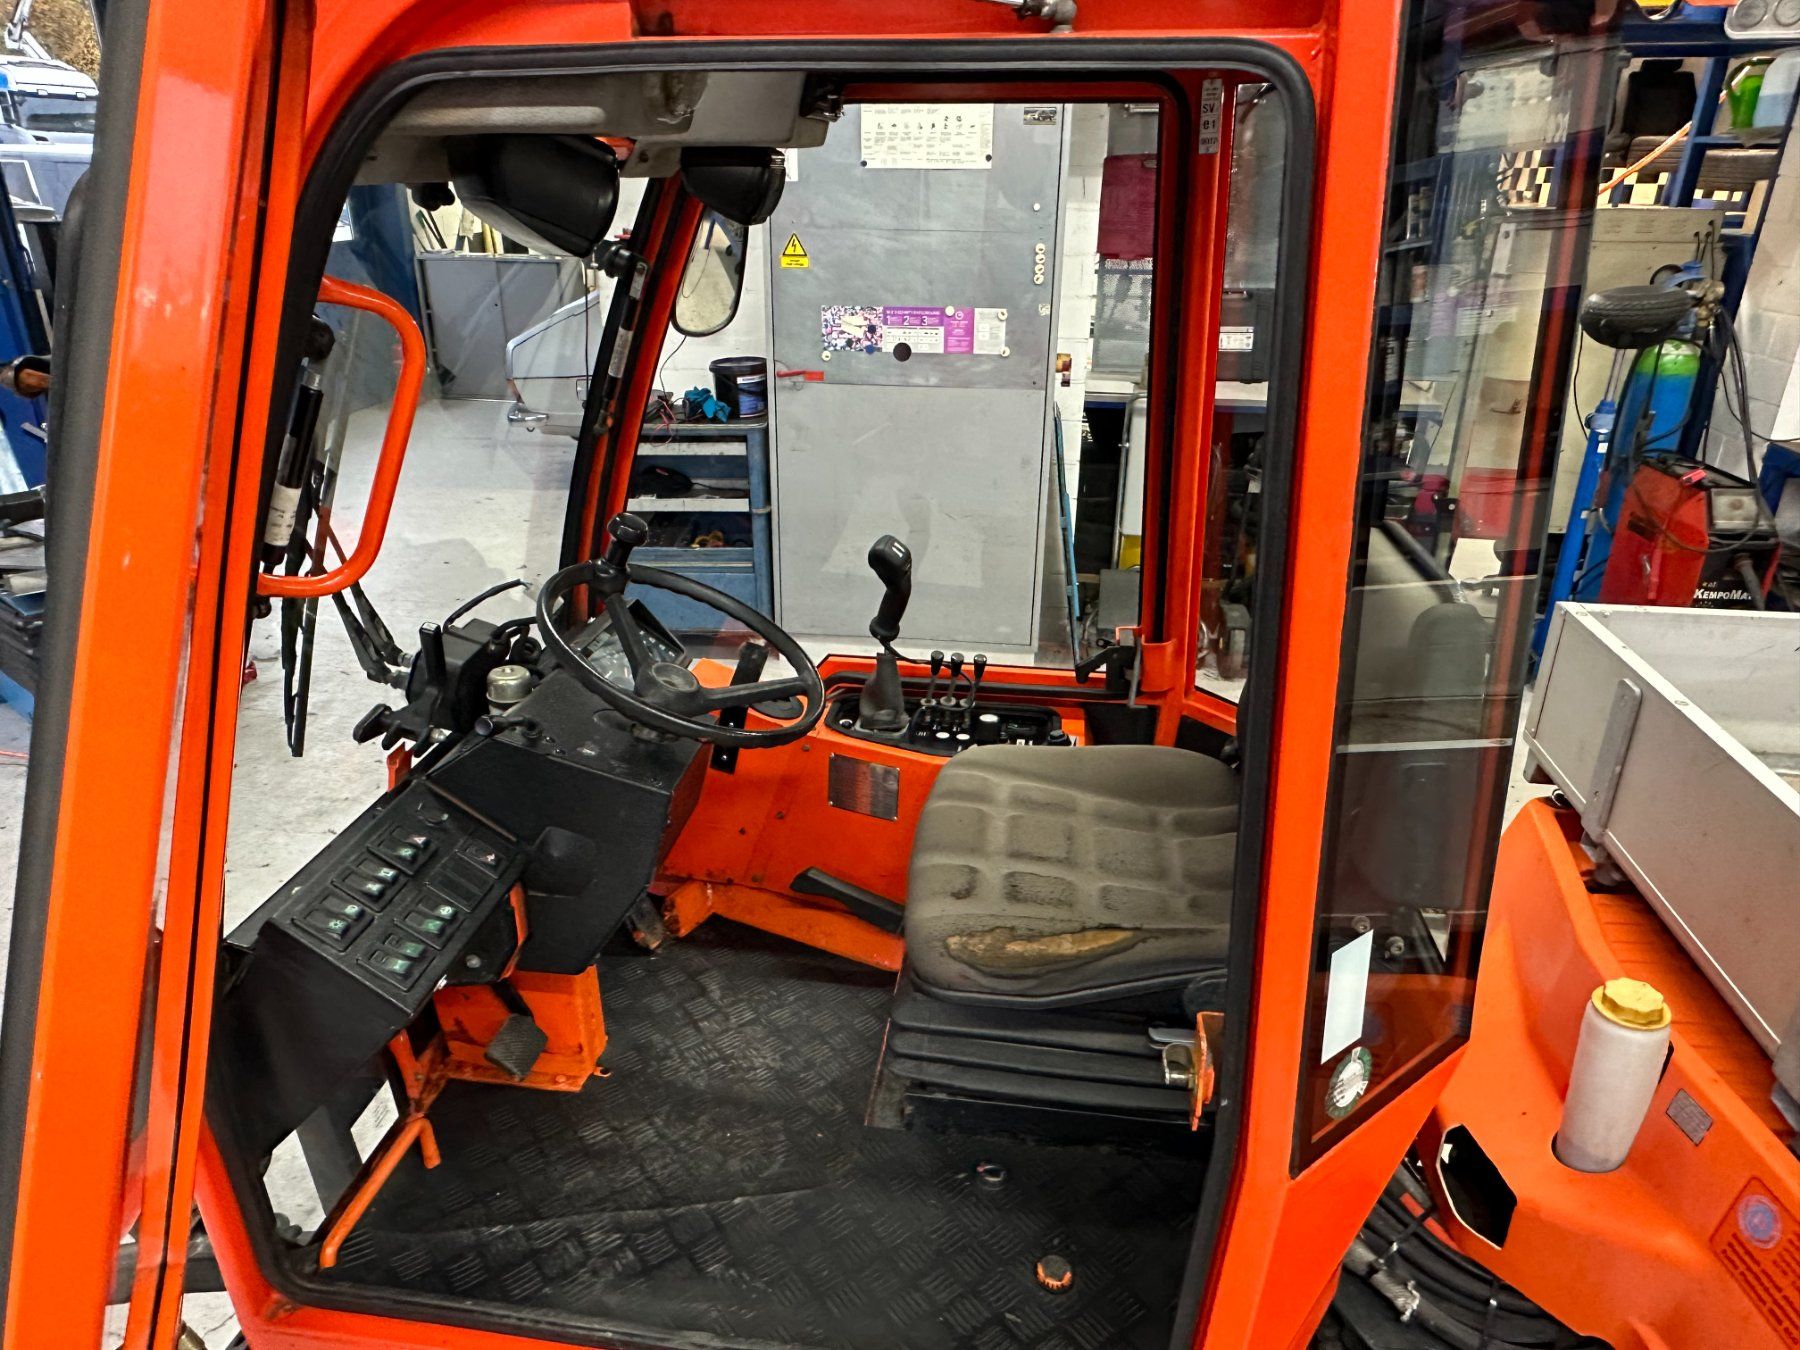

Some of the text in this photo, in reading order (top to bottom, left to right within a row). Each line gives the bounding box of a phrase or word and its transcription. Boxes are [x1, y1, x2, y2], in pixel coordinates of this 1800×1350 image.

[1202, 103, 1215, 114] SV
[903, 315, 910, 325] 2
[921, 315, 928, 325] 3
